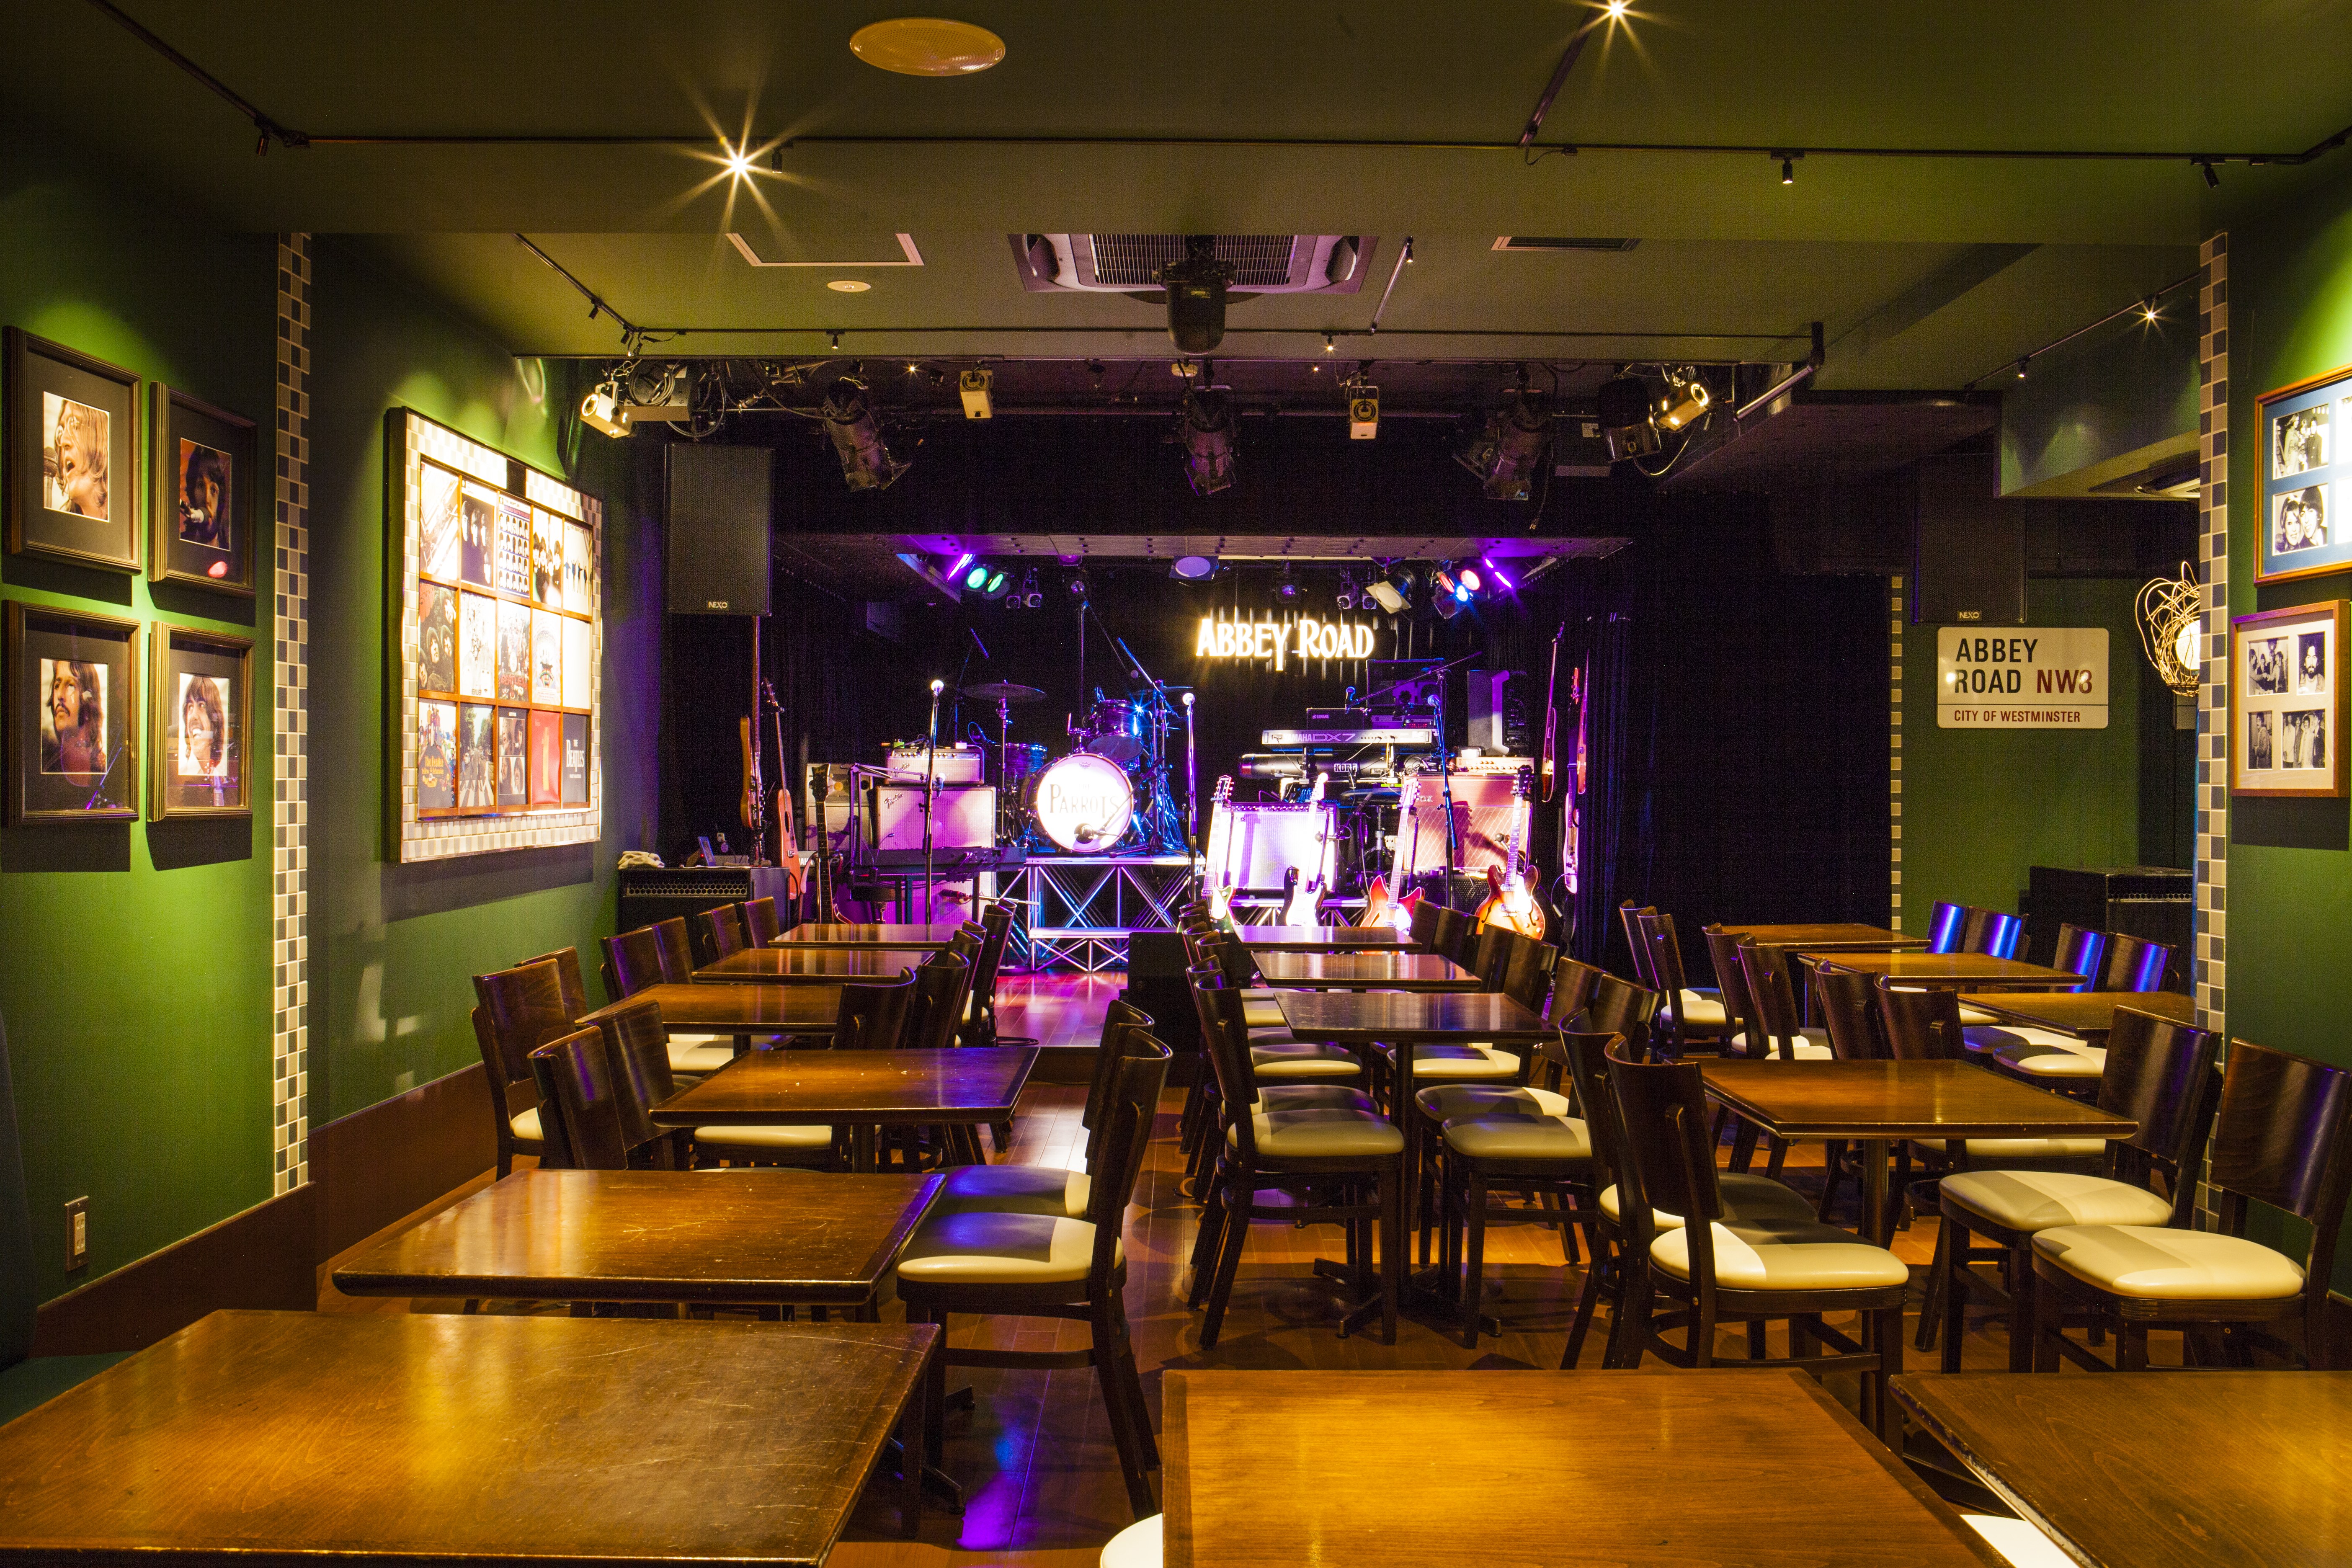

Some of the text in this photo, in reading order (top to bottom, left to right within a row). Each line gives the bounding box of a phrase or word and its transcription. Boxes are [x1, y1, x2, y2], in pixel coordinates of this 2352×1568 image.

[1196, 618, 1374, 671] ABBEY ROAD
[1955, 638, 2038, 663] ABBEY
[1955, 669, 2021, 694] ROAD
[1954, 710, 2081, 722] CITY OF WESTMINSTER
[1283, 733, 1356, 742] YAMAHA DX7
[566, 739, 585, 772] BEATLES
[1050, 784, 1119, 819] PARROTS
